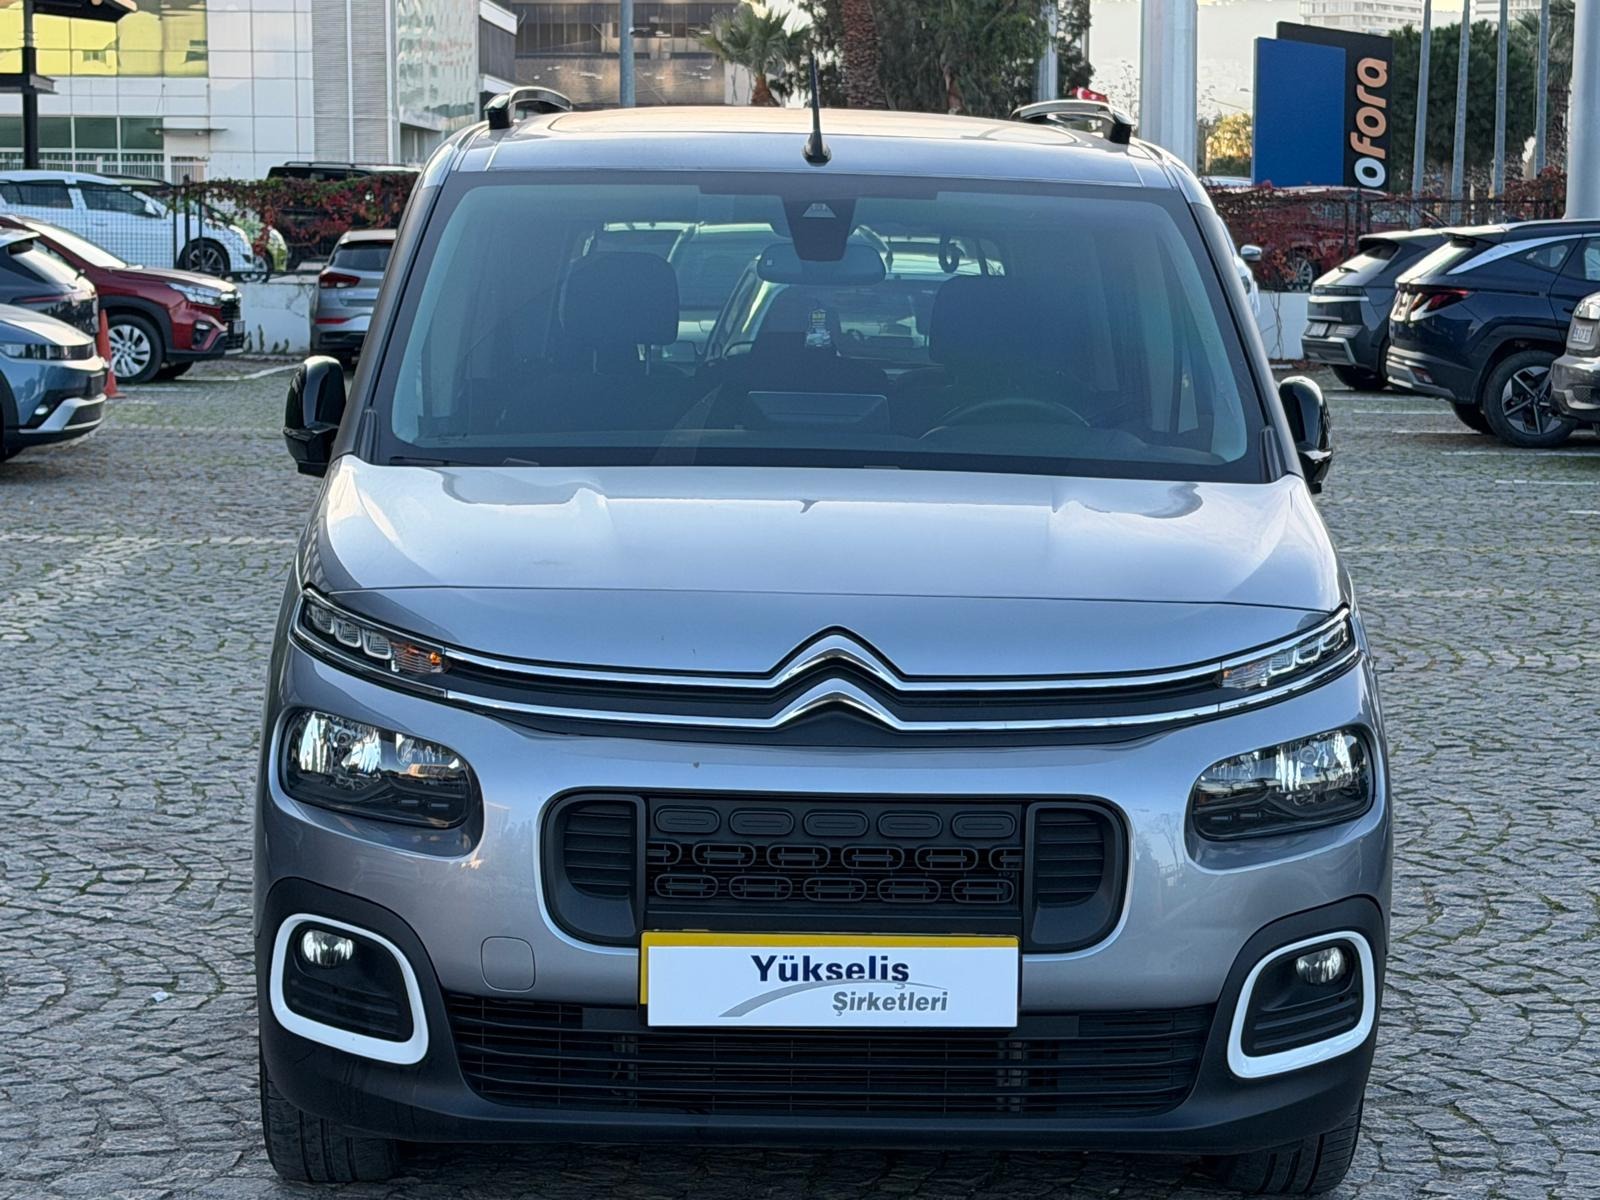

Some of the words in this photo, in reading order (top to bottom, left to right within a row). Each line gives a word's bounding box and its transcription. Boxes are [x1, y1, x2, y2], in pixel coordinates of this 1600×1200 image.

[1350, 57, 1388, 188] ofora
[750, 954, 910, 990] Yükseliş
[832, 991, 949, 1017] Şirketleri
